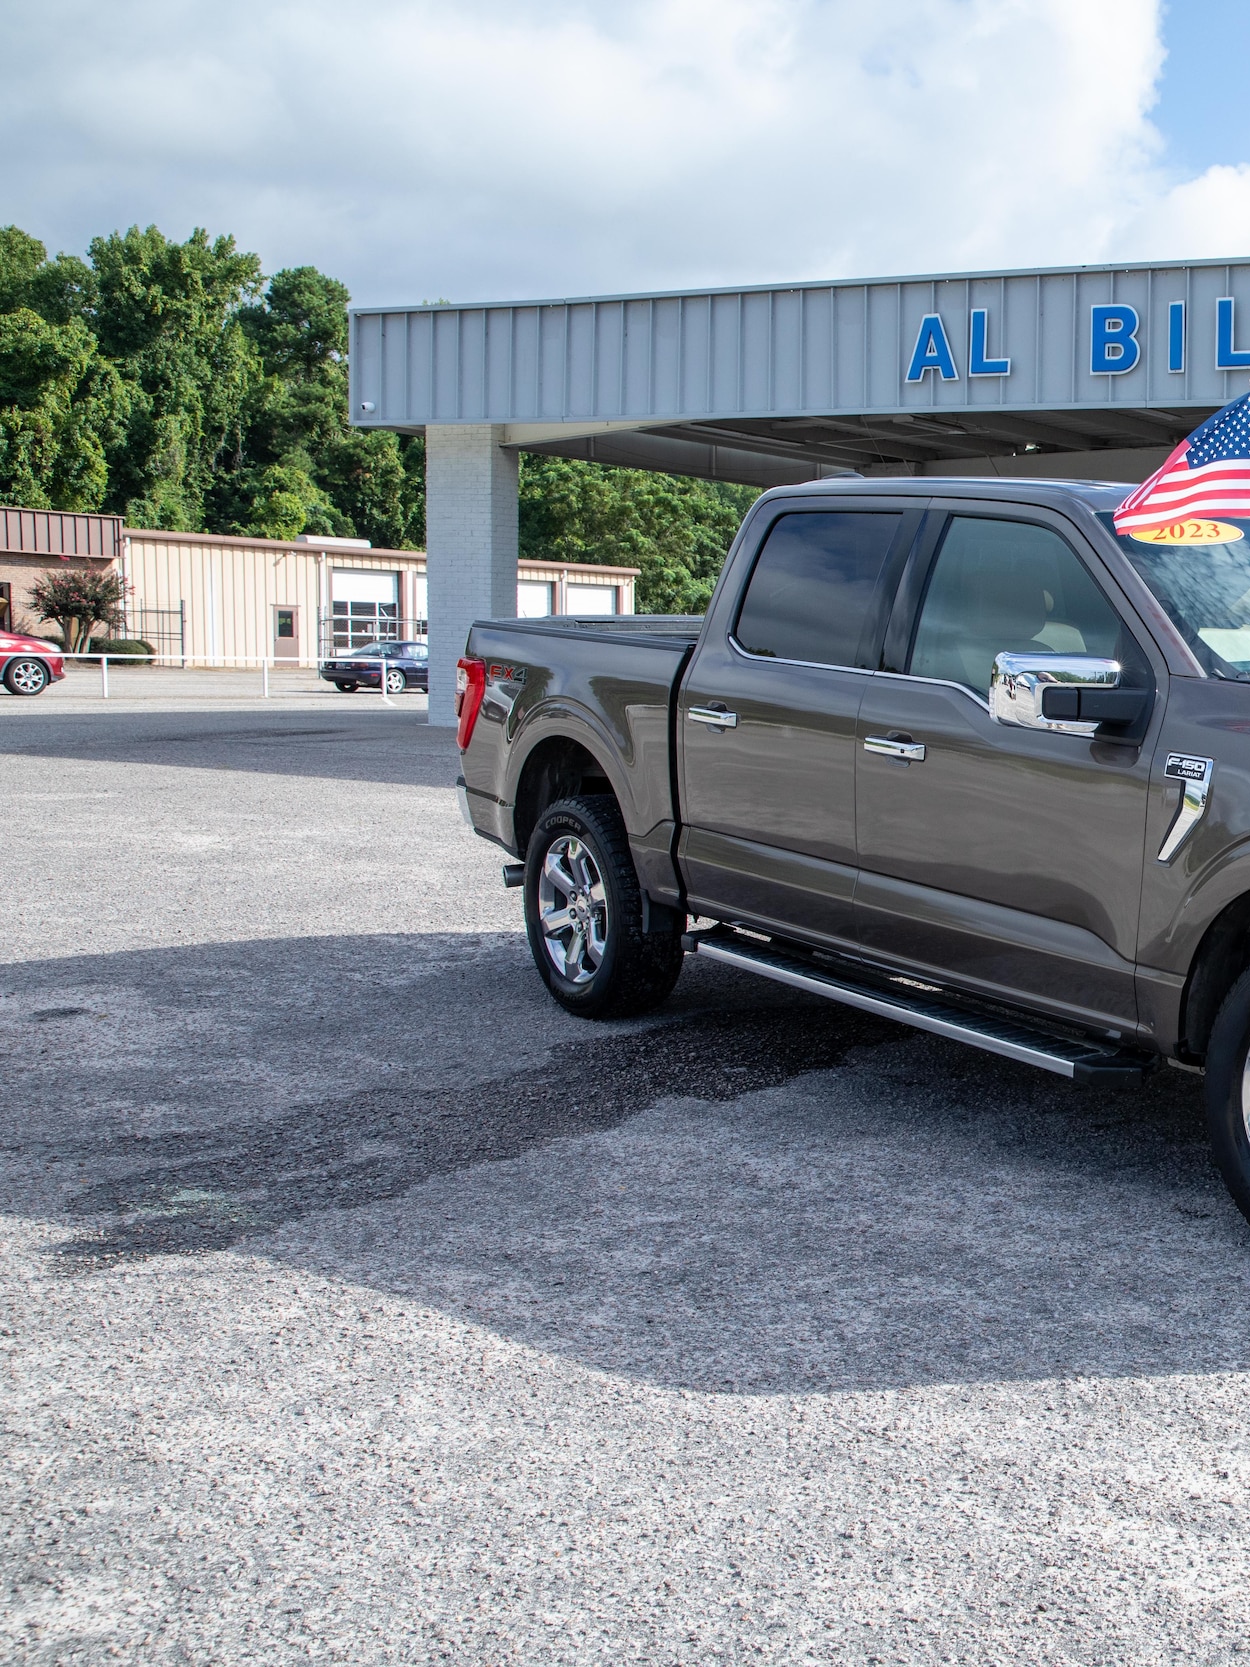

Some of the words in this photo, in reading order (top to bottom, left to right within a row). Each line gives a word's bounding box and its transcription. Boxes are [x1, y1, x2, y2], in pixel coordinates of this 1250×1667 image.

[905, 312, 1012, 384] AL
[1153, 523, 1221, 541] 2023
[489, 664, 528, 686] FX4
[1167, 757, 1206, 772] F-150
[1177, 769, 1202, 778] LARIAT
[545, 815, 582, 833] COOPER
